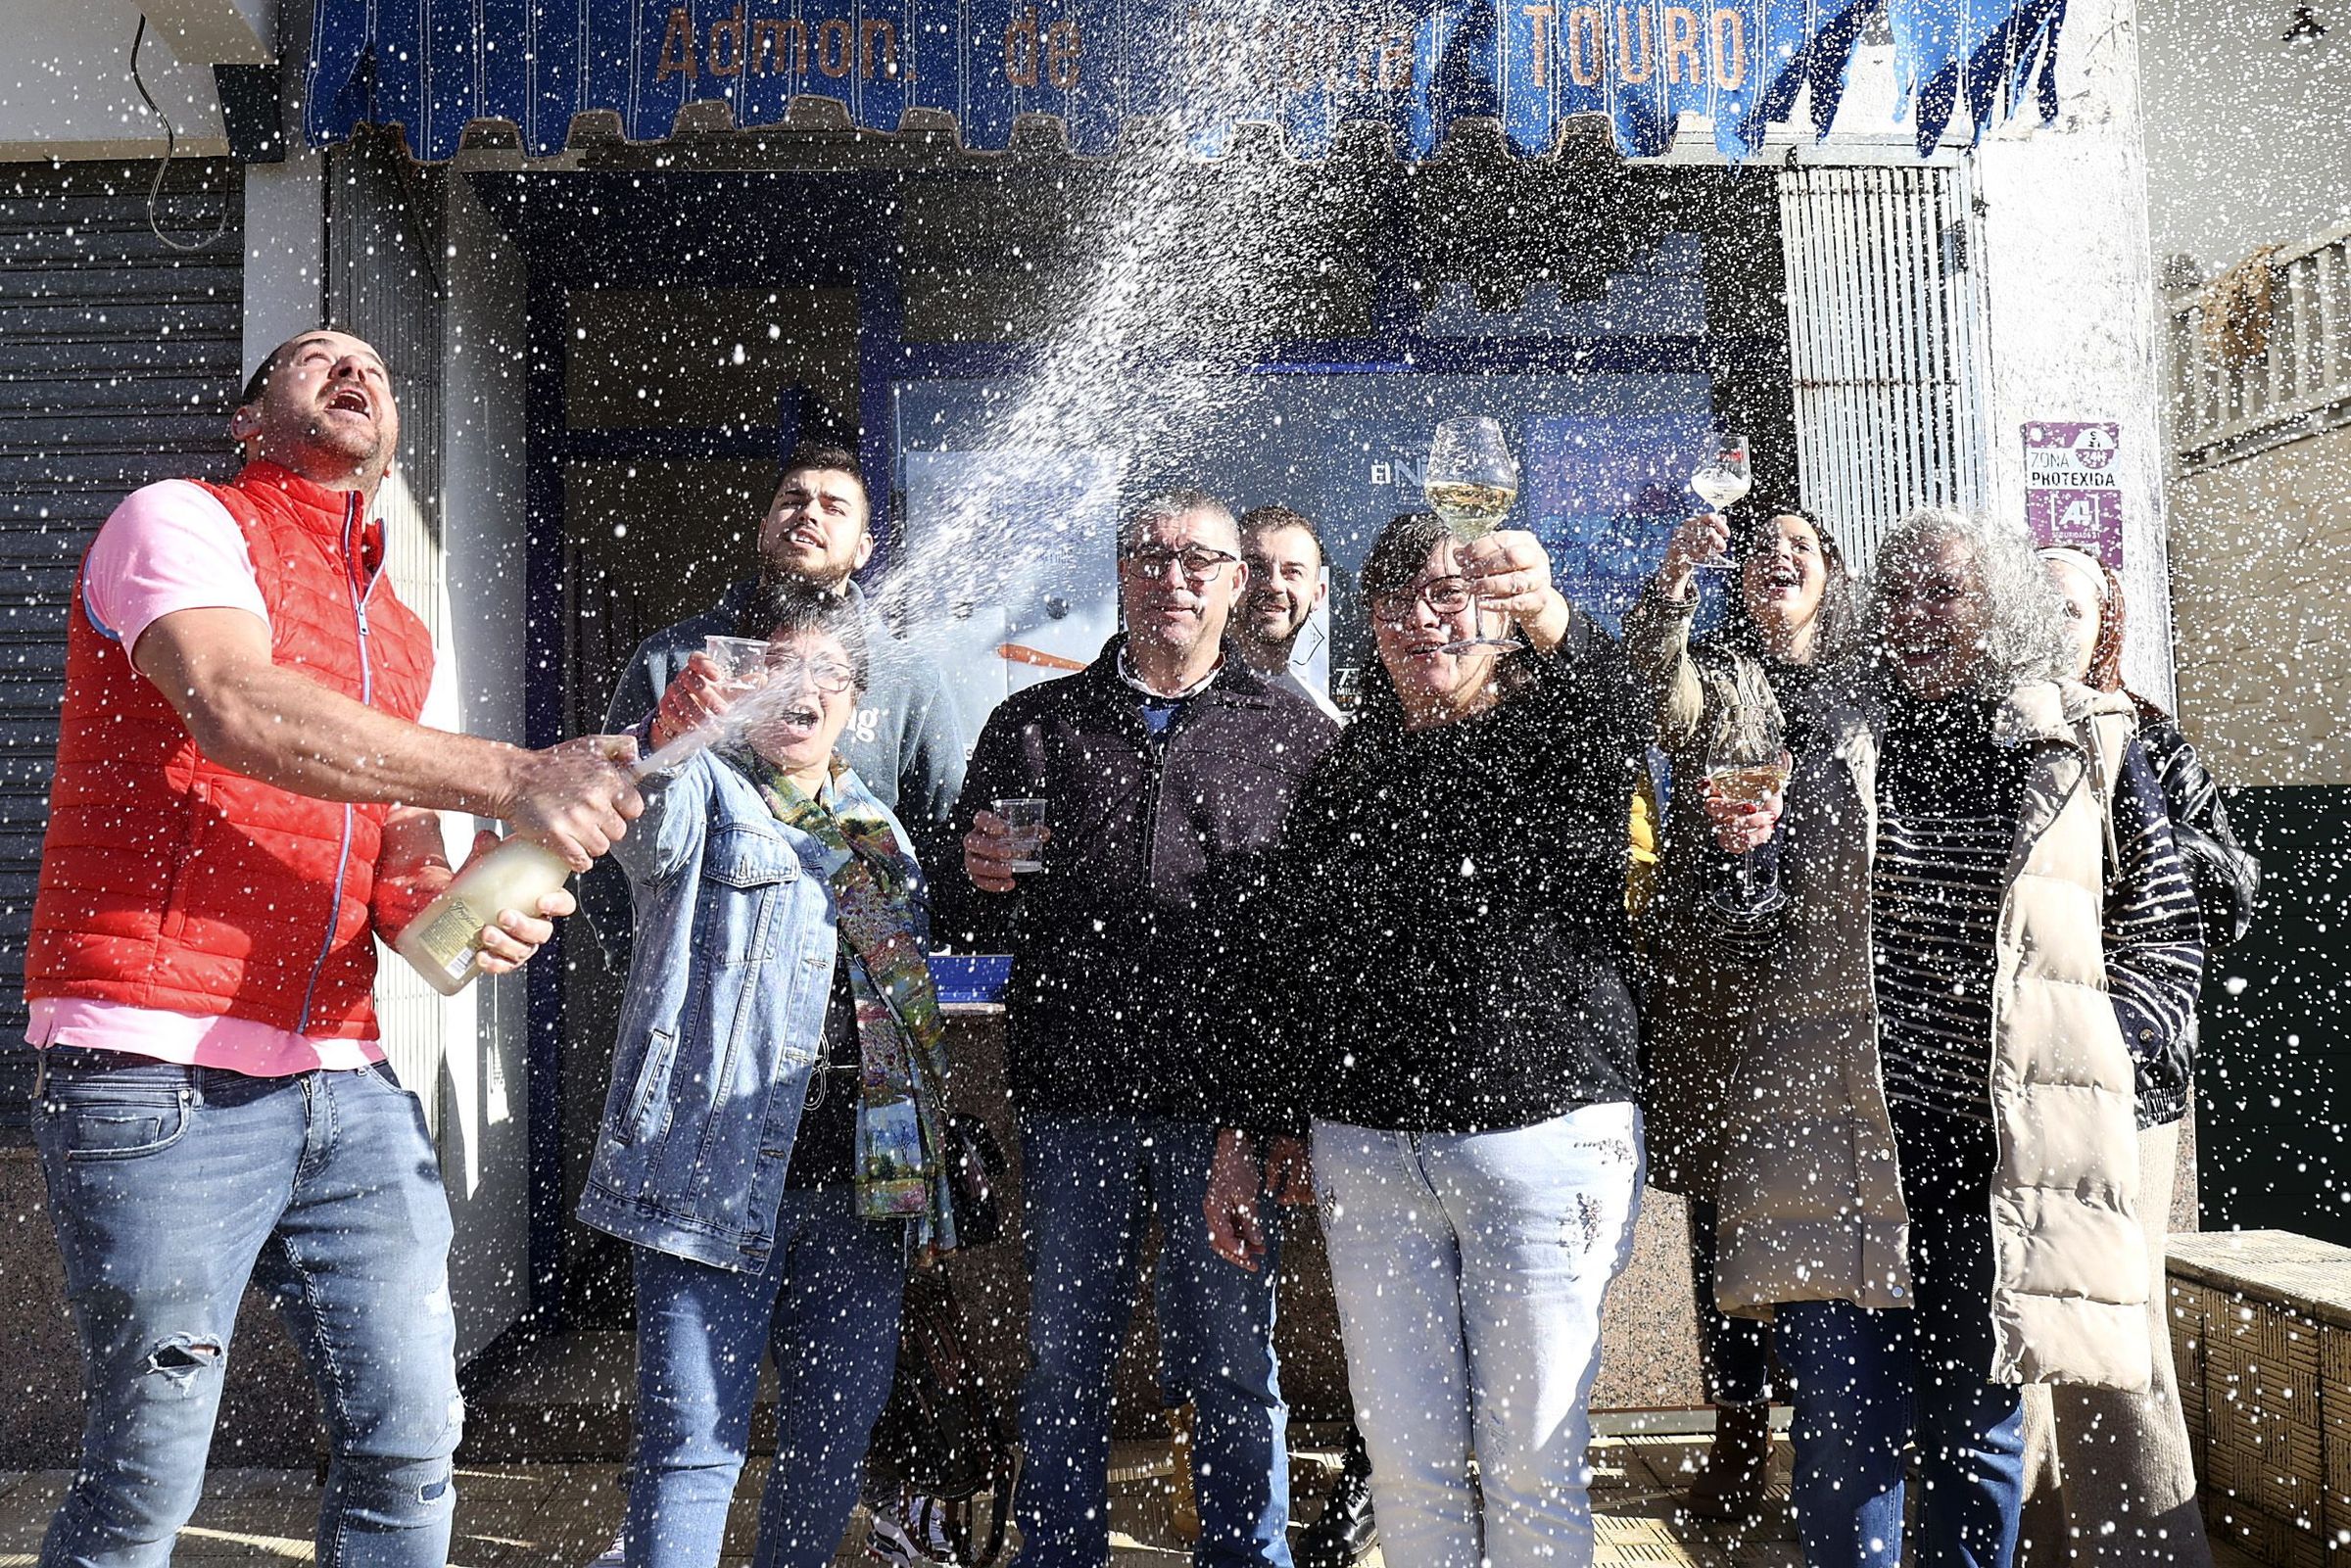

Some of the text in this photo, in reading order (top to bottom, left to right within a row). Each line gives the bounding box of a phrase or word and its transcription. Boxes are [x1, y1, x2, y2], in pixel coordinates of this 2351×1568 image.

[656, 6, 918, 83] Admon.
[1003, 5, 1082, 88] de
[1521, 5, 1746, 91] TOURO
[2031, 451, 2070, 468] ZONA
[2032, 471, 2116, 487] PROTEXIDA
